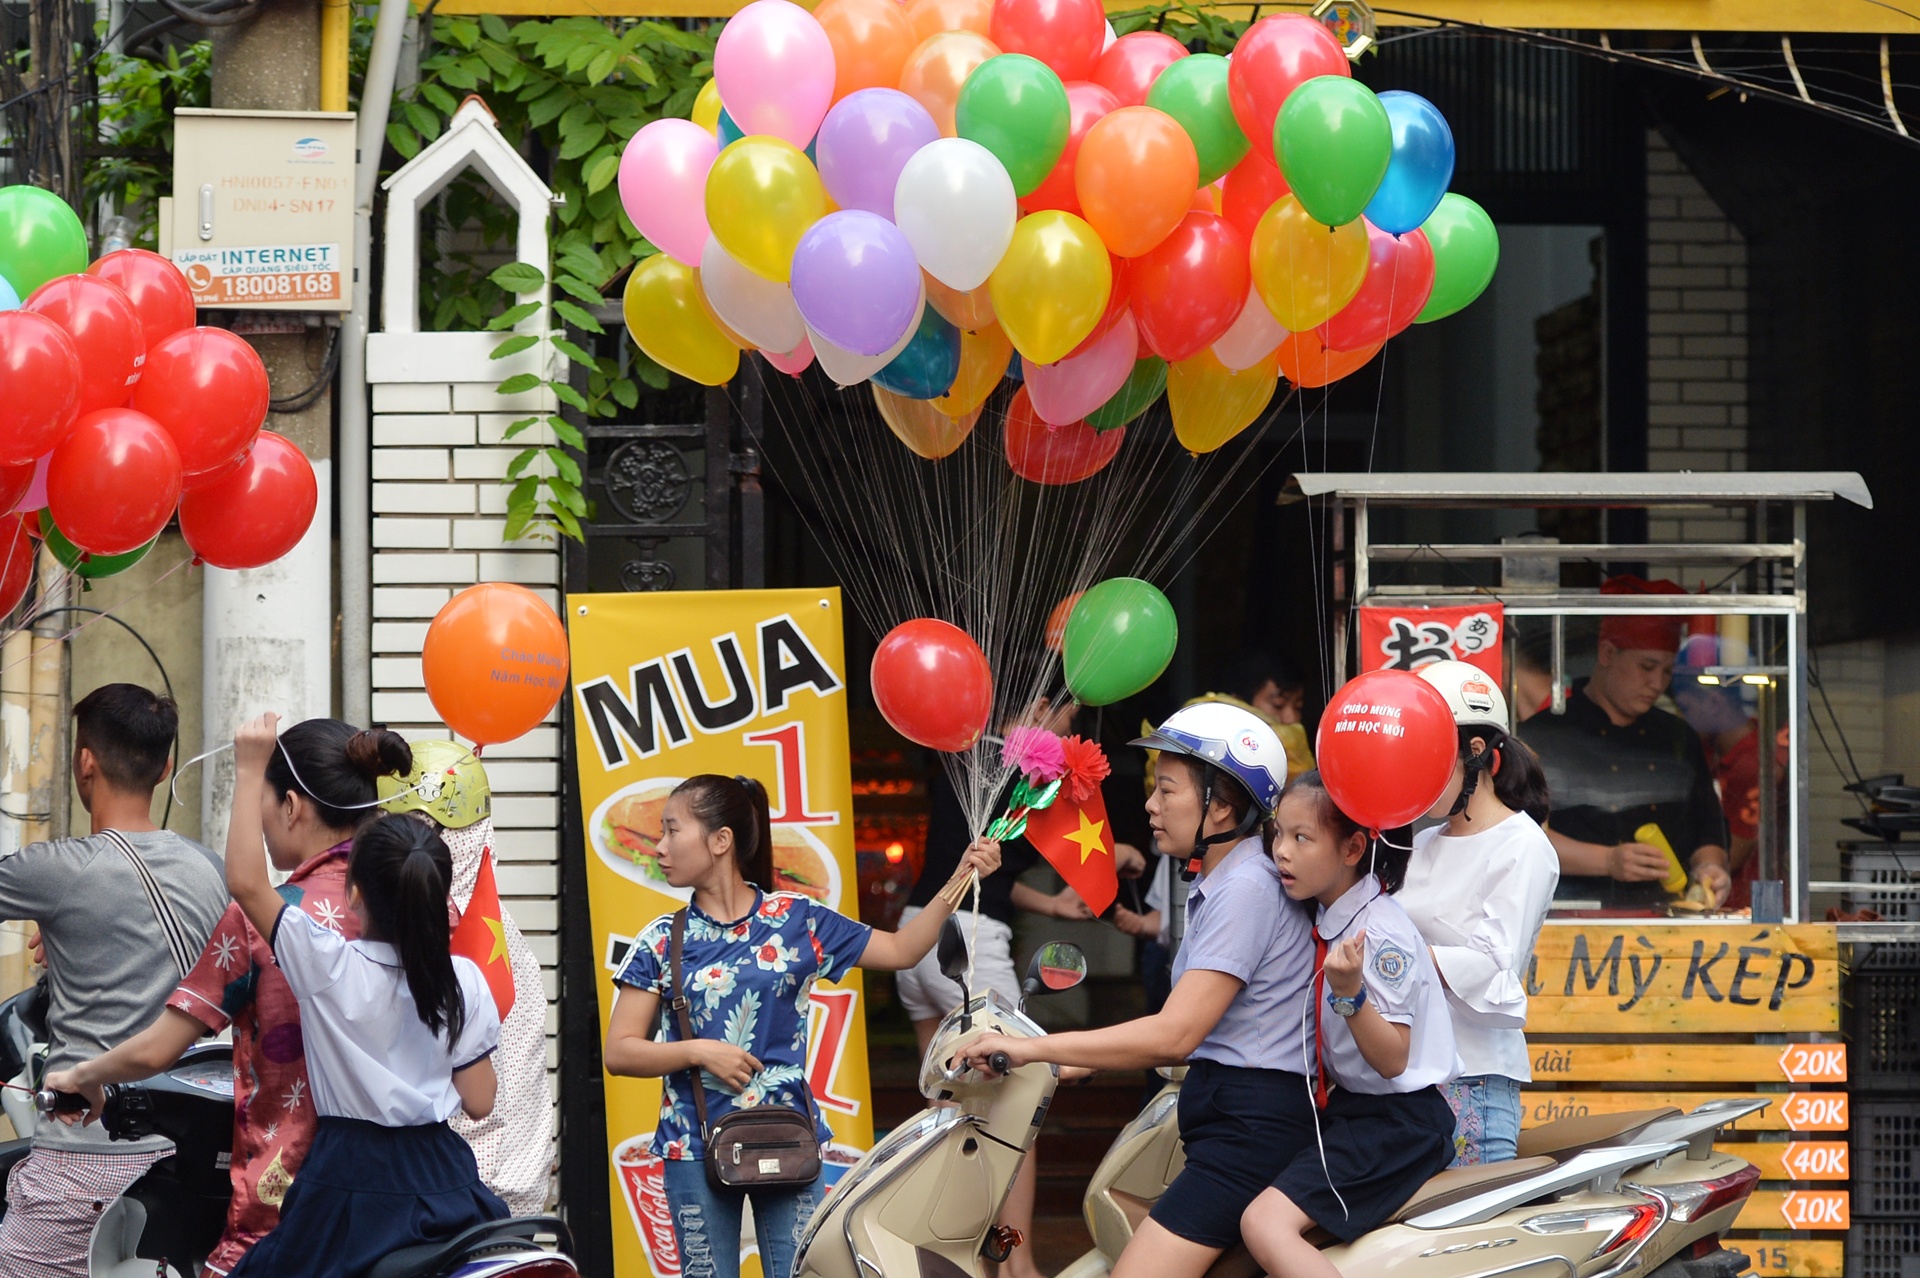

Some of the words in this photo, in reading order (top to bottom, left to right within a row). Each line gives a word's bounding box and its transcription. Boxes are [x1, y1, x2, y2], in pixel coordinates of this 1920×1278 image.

[222, 247, 331, 265] INTERNET
[245, 264, 281, 274] QUANG
[222, 273, 333, 296] 18008168
[576, 613, 844, 772] MUA
[1342, 703, 1369, 715] CHÀO
[1369, 704, 1402, 719] MỪNG
[1357, 720, 1381, 735] HỌC
[1382, 723, 1405, 738] MỚI
[743, 721, 840, 826] 1
[1564, 934, 1662, 1012] Mỳ
[1534, 1050, 1572, 1073] dài
[1792, 1050, 1844, 1076] 20K
[1794, 1099, 1845, 1125] 30K
[1794, 1148, 1846, 1174] 40K
[1795, 1197, 1844, 1223] 10K
[1756, 1246, 1788, 1269] 15
